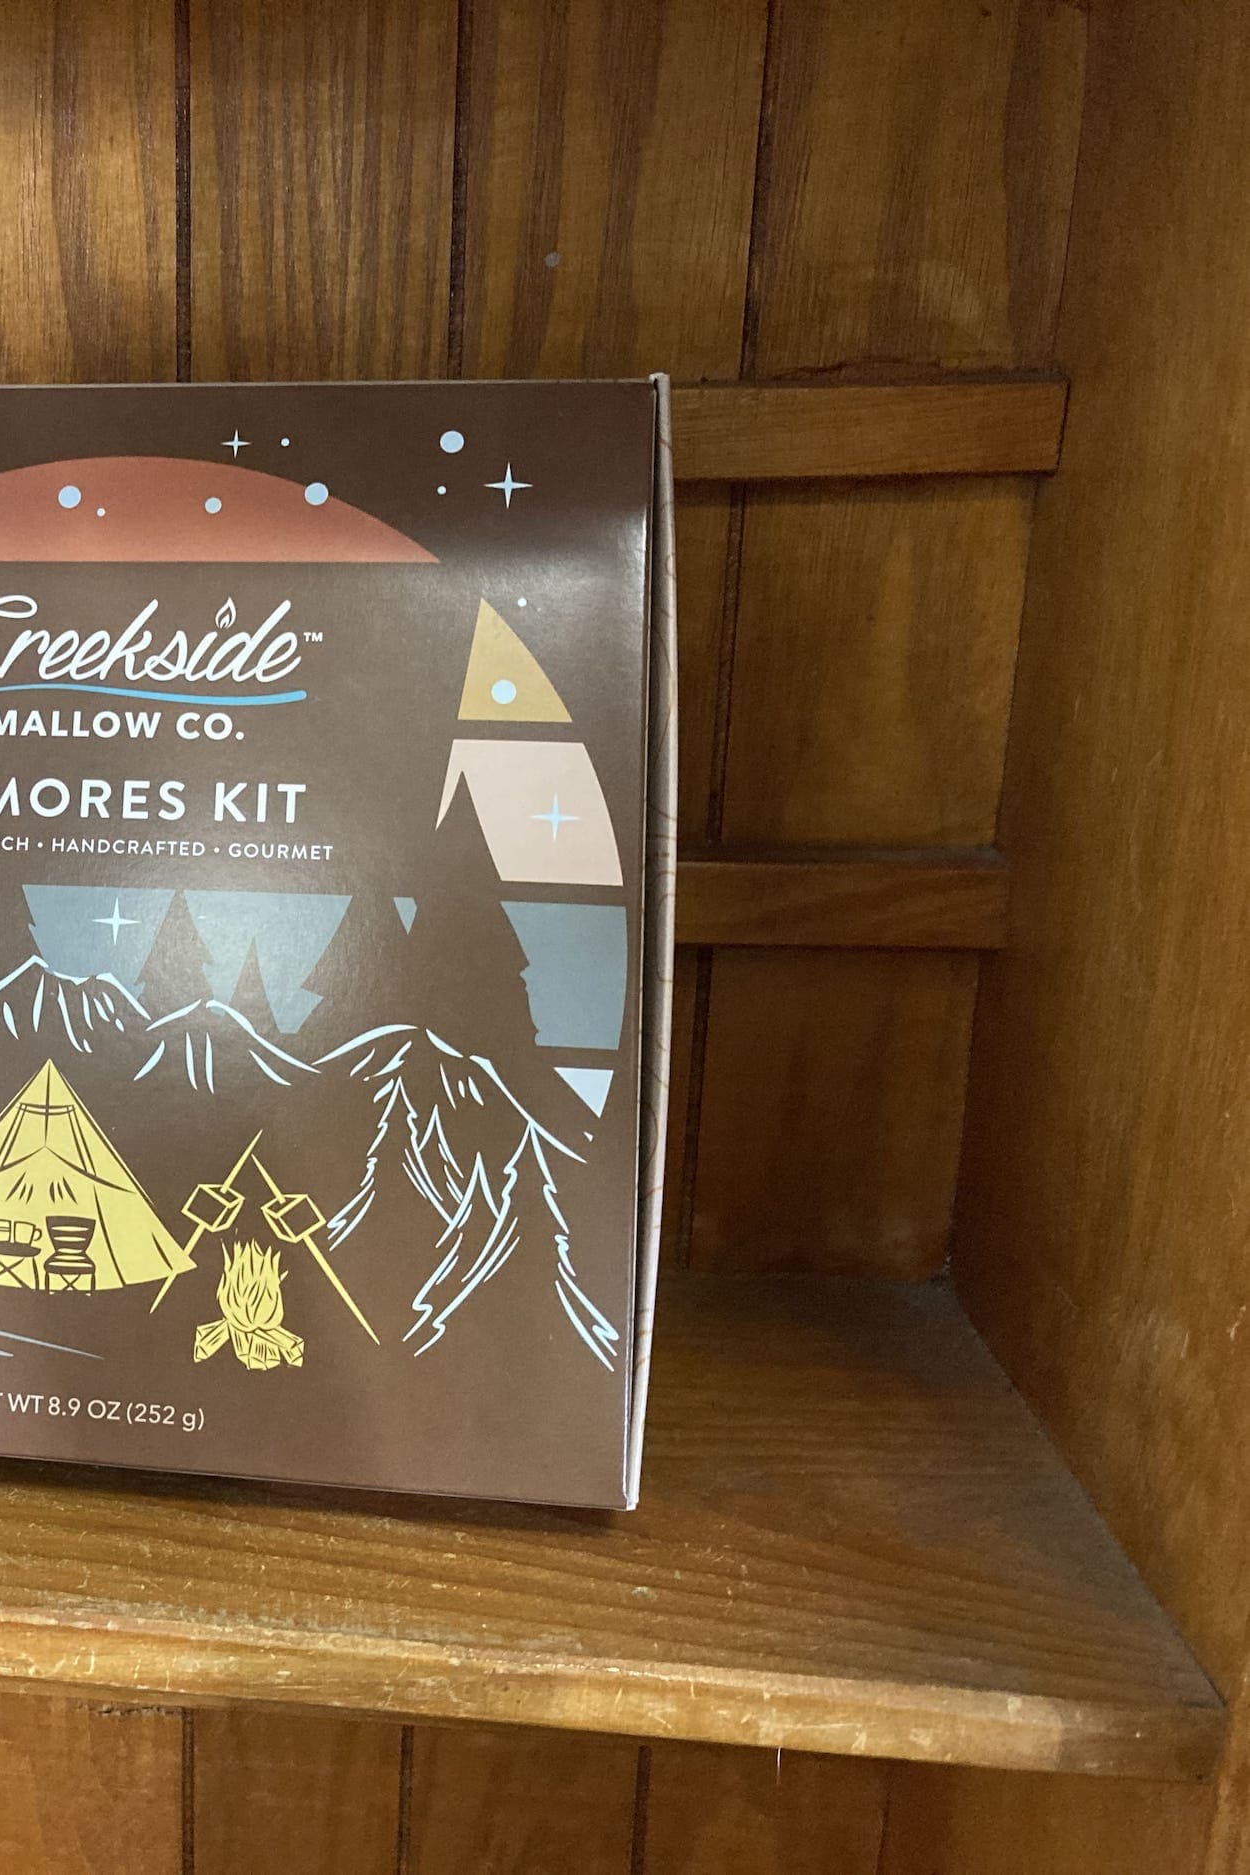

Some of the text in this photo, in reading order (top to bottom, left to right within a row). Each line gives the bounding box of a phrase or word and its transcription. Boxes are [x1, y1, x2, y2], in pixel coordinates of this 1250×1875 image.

[177, 713, 244, 739] CO.
[215, 783, 306, 823] KIT
[53, 839, 205, 856] HANDCRAFTED
[229, 843, 333, 859] GOURMET
[8, 1393, 44, 1413] WT
[49, 1397, 80, 1416] 8.9
[88, 1400, 120, 1419] OZ
[127, 1403, 174, 1424] (252
[183, 1409, 204, 1431] g)
